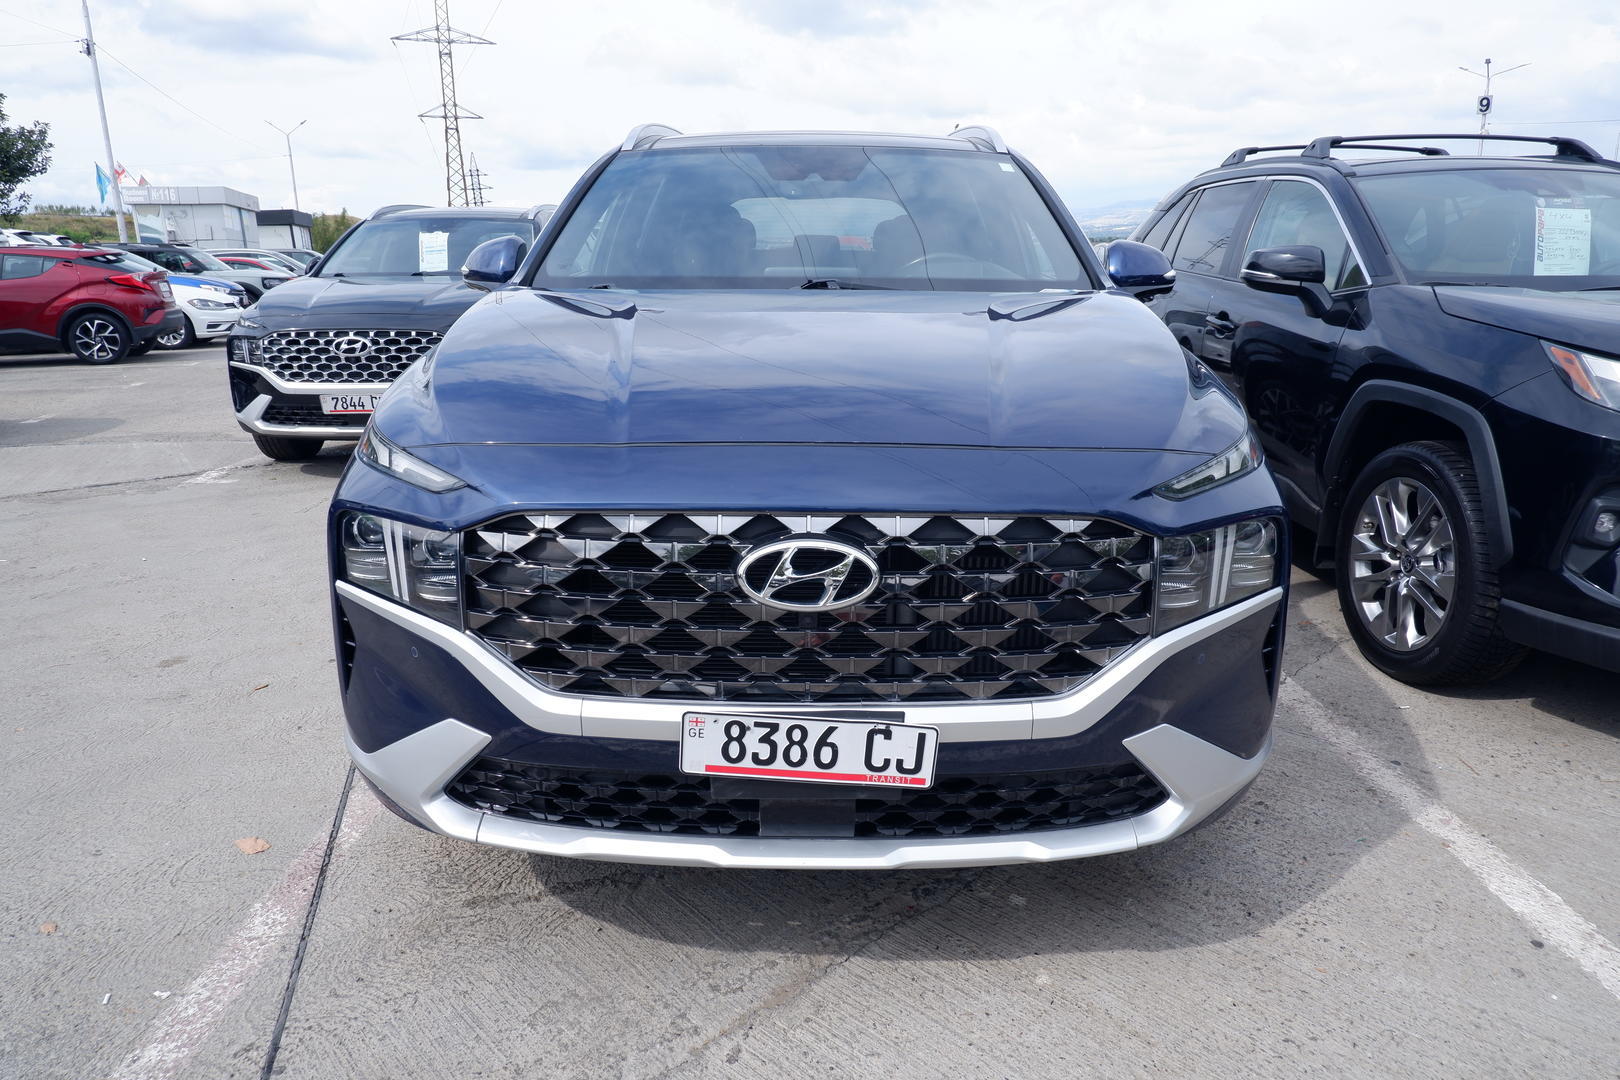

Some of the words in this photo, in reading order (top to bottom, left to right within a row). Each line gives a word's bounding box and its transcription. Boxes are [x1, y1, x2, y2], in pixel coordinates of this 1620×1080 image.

[1479, 97, 1490, 113] 9
[331, 396, 365, 410] 7844
[688, 727, 705, 738] GE
[720, 719, 839, 770] 8386
[863, 726, 926, 776] CJ
[865, 774, 912, 785] TRANSIT
